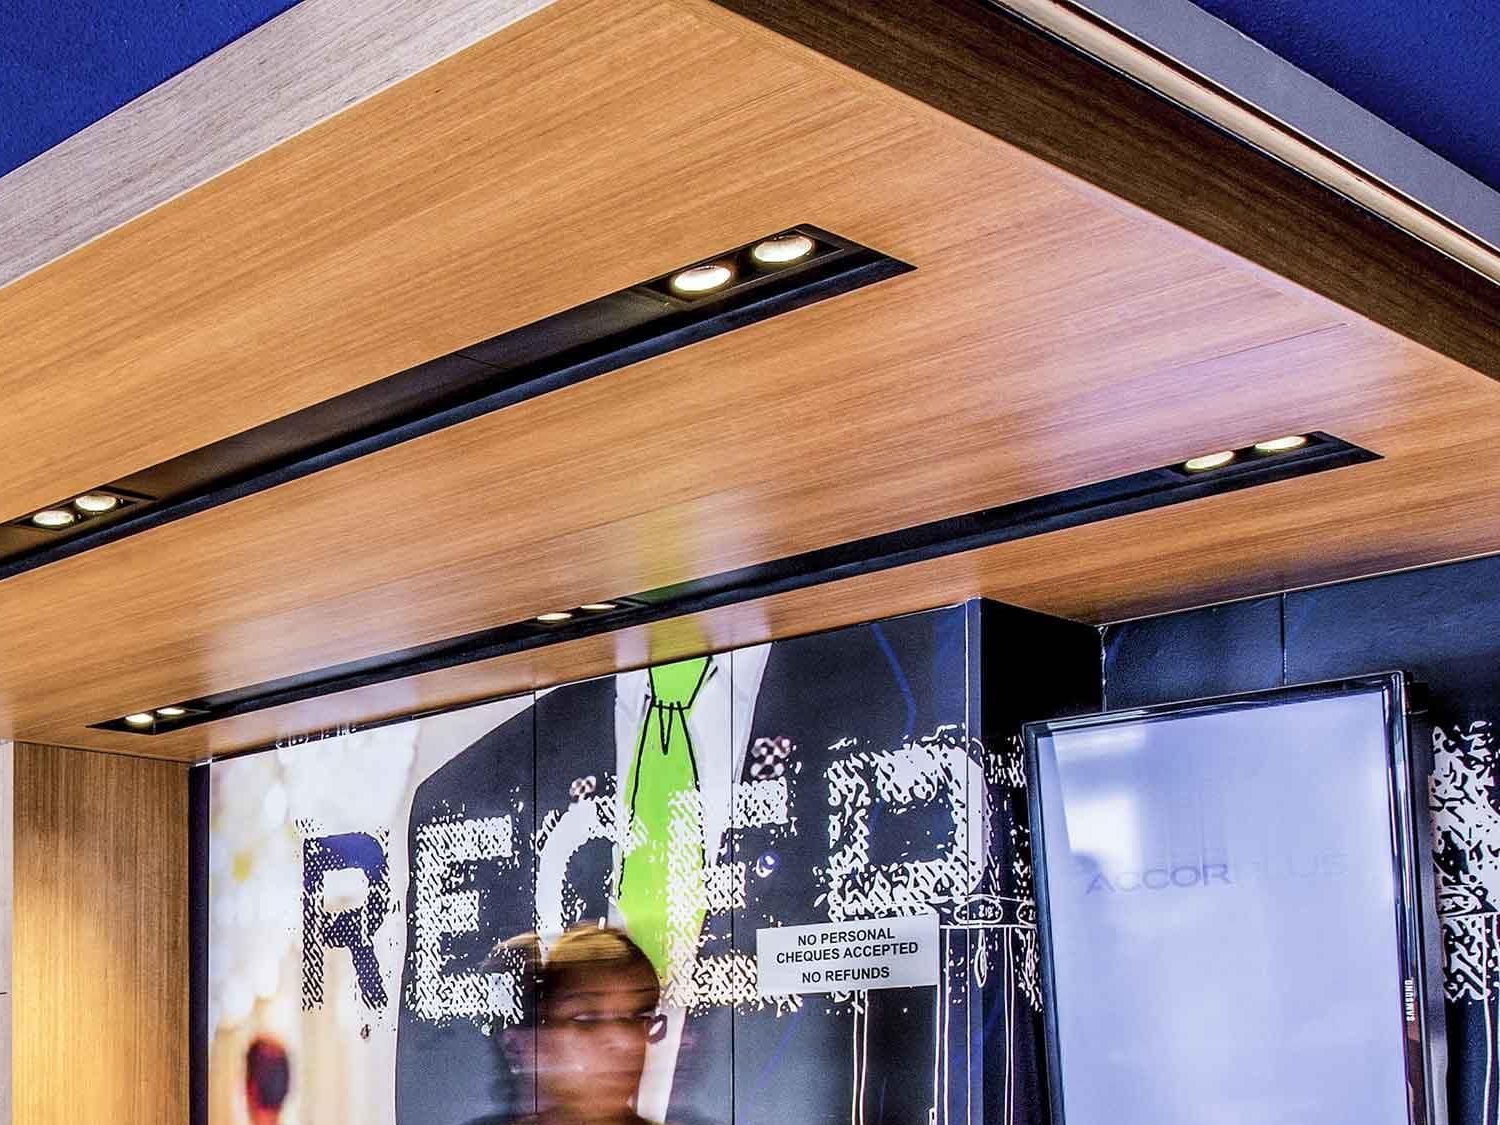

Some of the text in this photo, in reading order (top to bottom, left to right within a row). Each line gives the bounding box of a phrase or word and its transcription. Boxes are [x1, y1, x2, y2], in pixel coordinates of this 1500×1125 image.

[1086, 863, 1234, 895] ACCOR
[797, 927, 896, 946] NO PERSONAL
[776, 941, 919, 964] CHEQUES ACCEPTED
[801, 966, 890, 984] NO REFUNDS
[1404, 979, 1416, 1022] SAMSUNG
